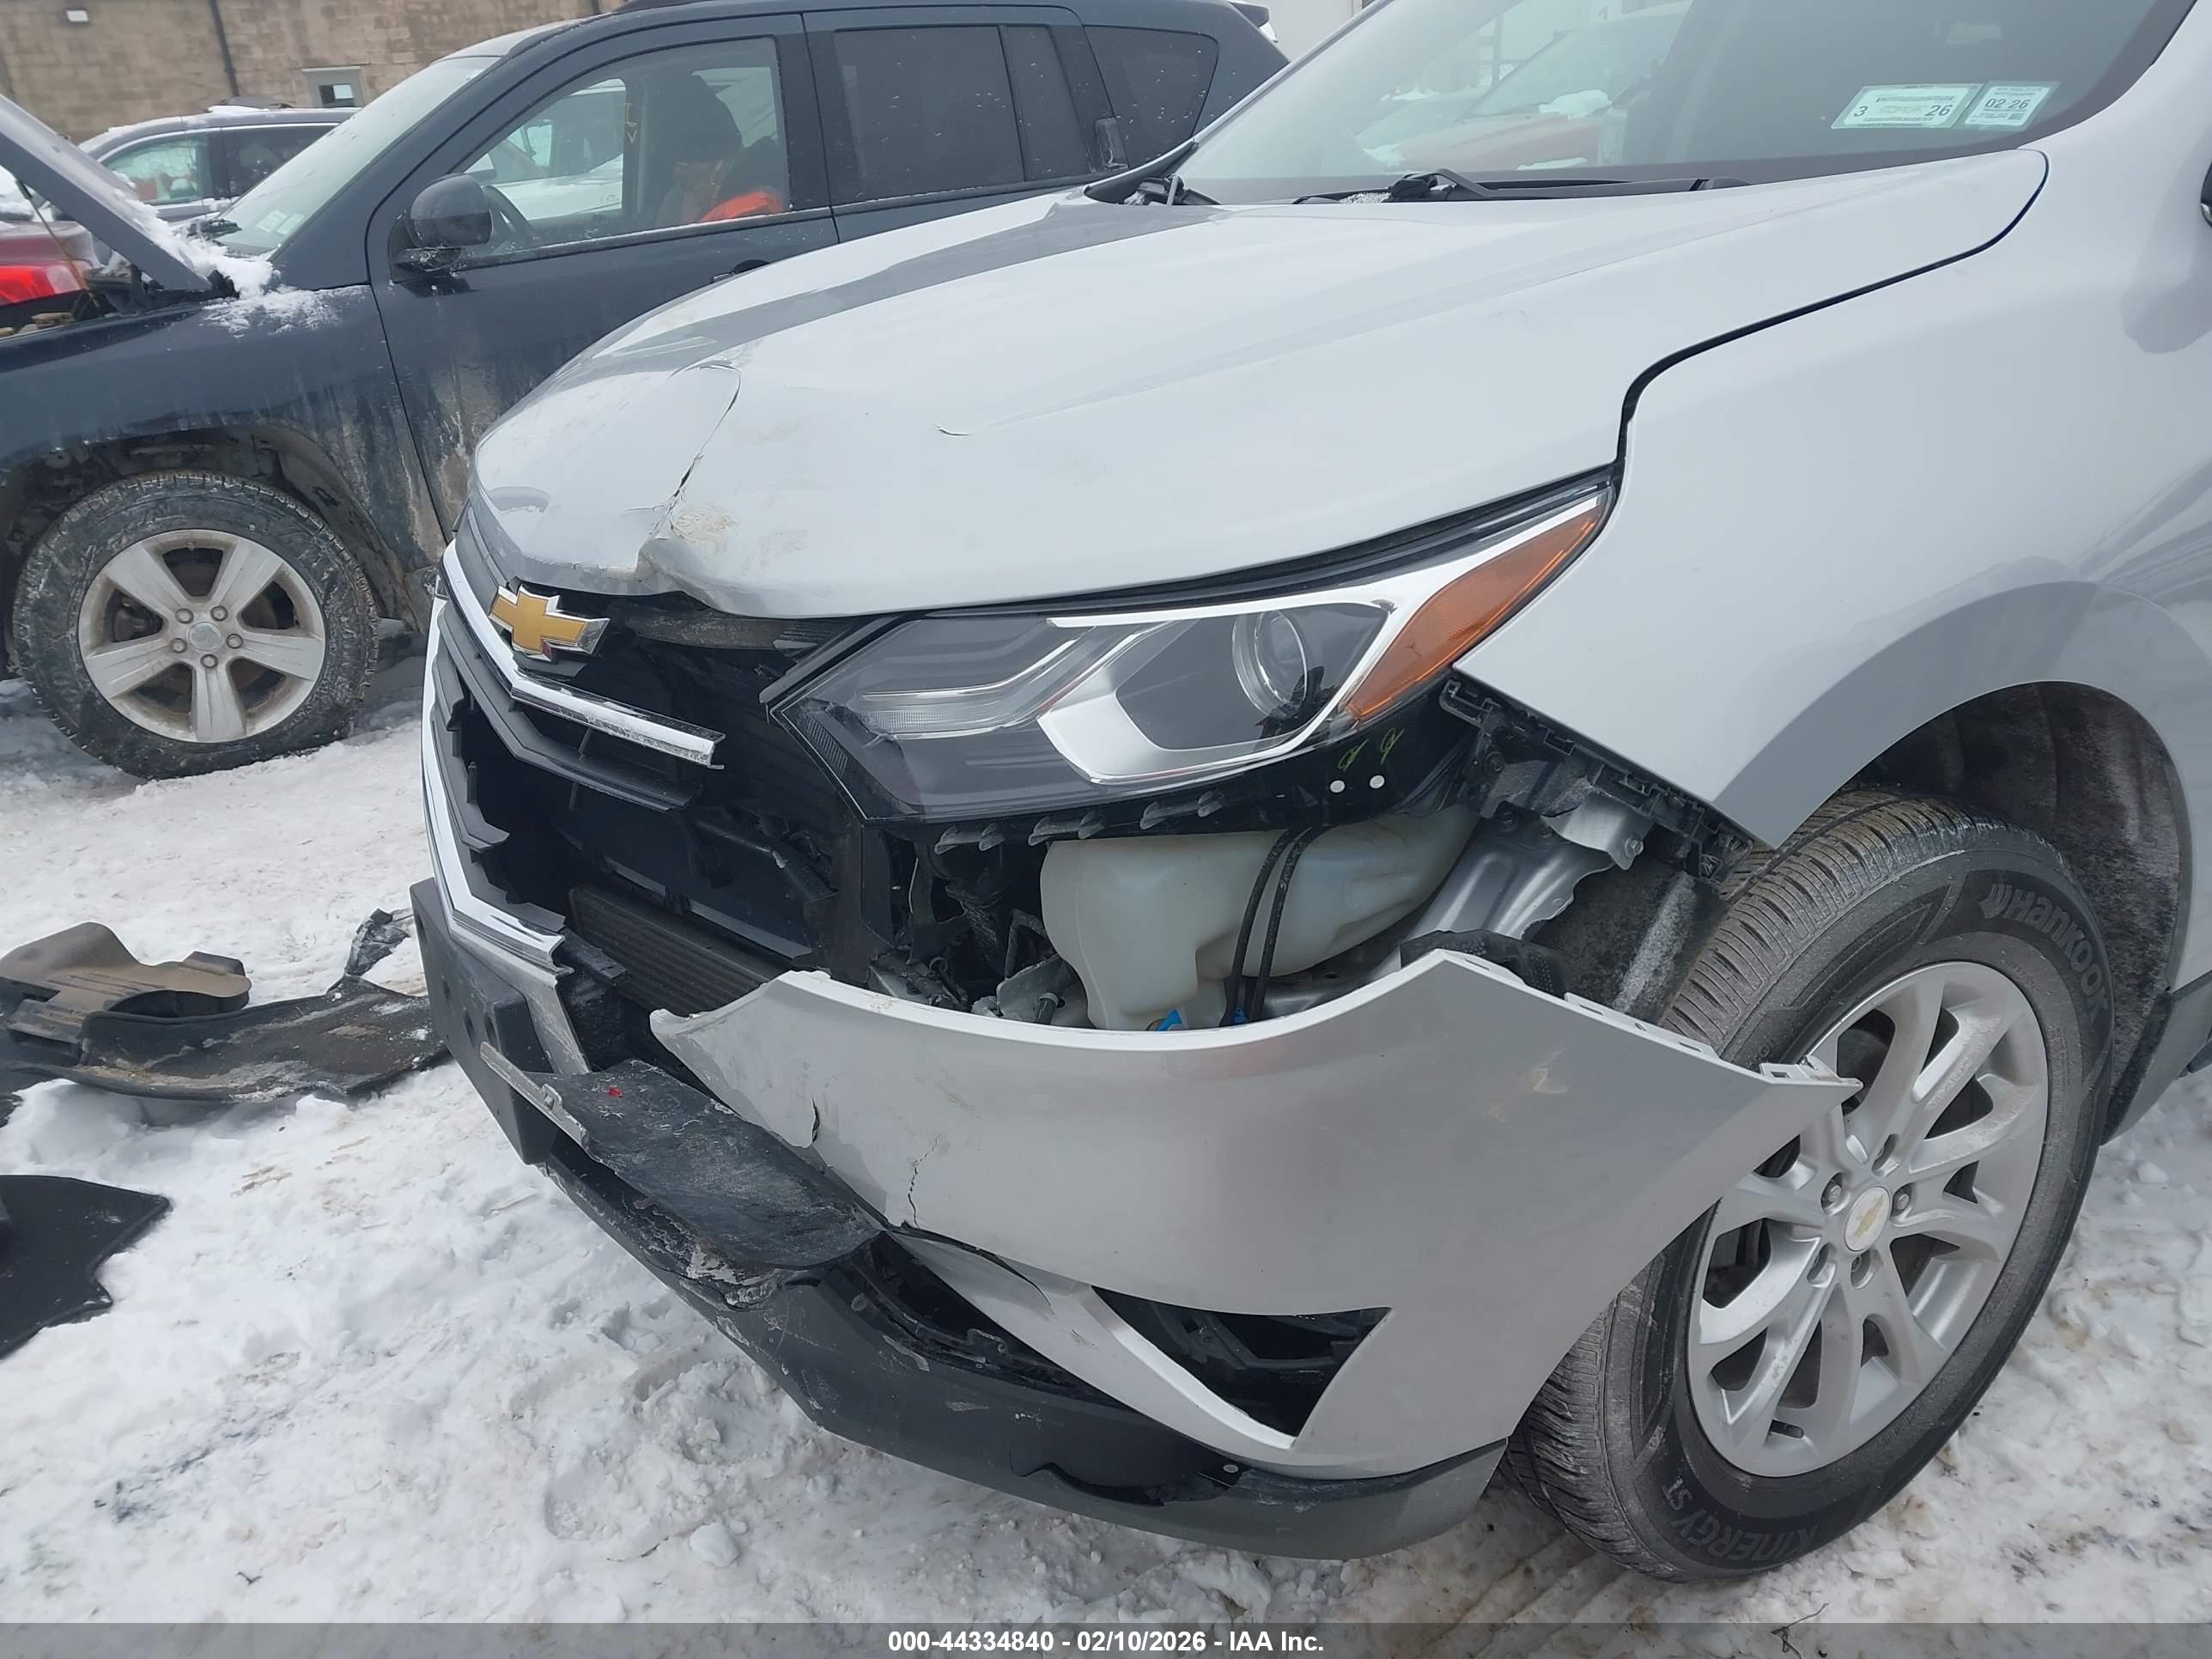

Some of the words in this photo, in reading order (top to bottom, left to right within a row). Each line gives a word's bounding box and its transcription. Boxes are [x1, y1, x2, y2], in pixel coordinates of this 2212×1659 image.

[1984, 98, 2007, 108] 02
[2008, 99, 2032, 109] 26
[1853, 105, 1869, 117] 3
[1923, 104, 1954, 117] 26
